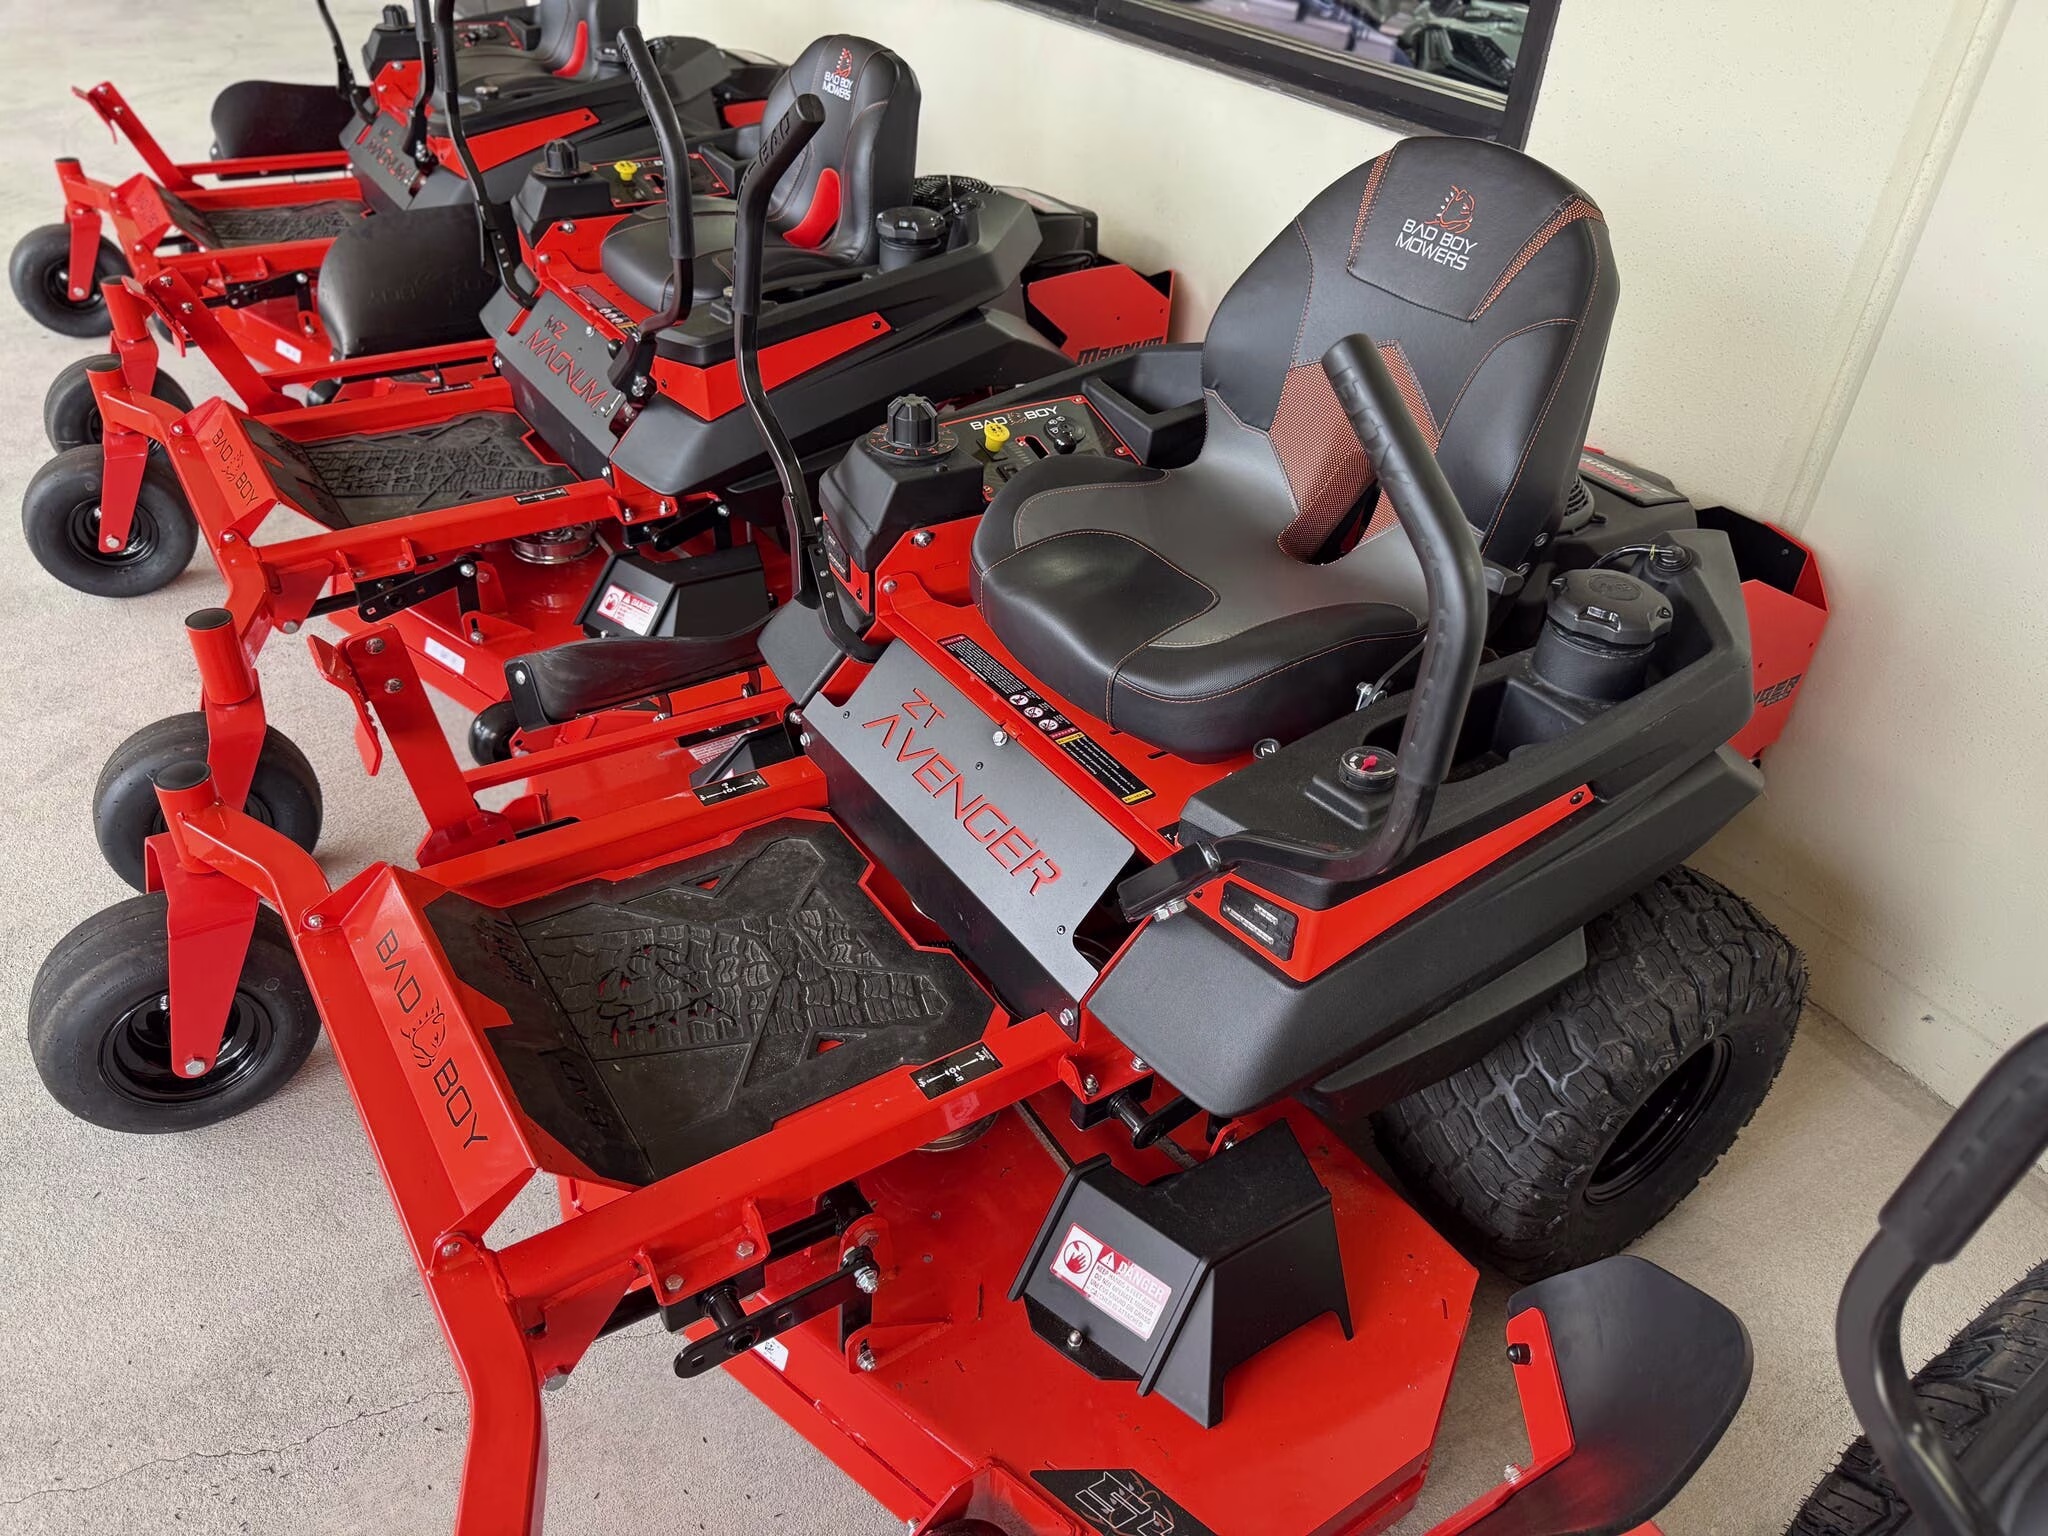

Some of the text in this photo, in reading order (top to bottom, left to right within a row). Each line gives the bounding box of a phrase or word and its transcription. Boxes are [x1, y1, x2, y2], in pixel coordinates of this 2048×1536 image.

[822, 81, 851, 101] MOWERS
[824, 71, 853, 89] BAD BOY
[1395, 231, 1470, 271] MOWERS
[1402, 218, 1478, 254] BAD BOY
[545, 314, 568, 340] MZ
[526, 328, 608, 409] MAGNUM
[1024, 406, 1058, 420] BOY
[212, 428, 259, 506] BAD BOY
[902, 687, 946, 729] ZT
[862, 714, 1063, 897] AVENGER
[376, 928, 488, 1150] BAD BOY
[1116, 1260, 1166, 1299] DANGER
